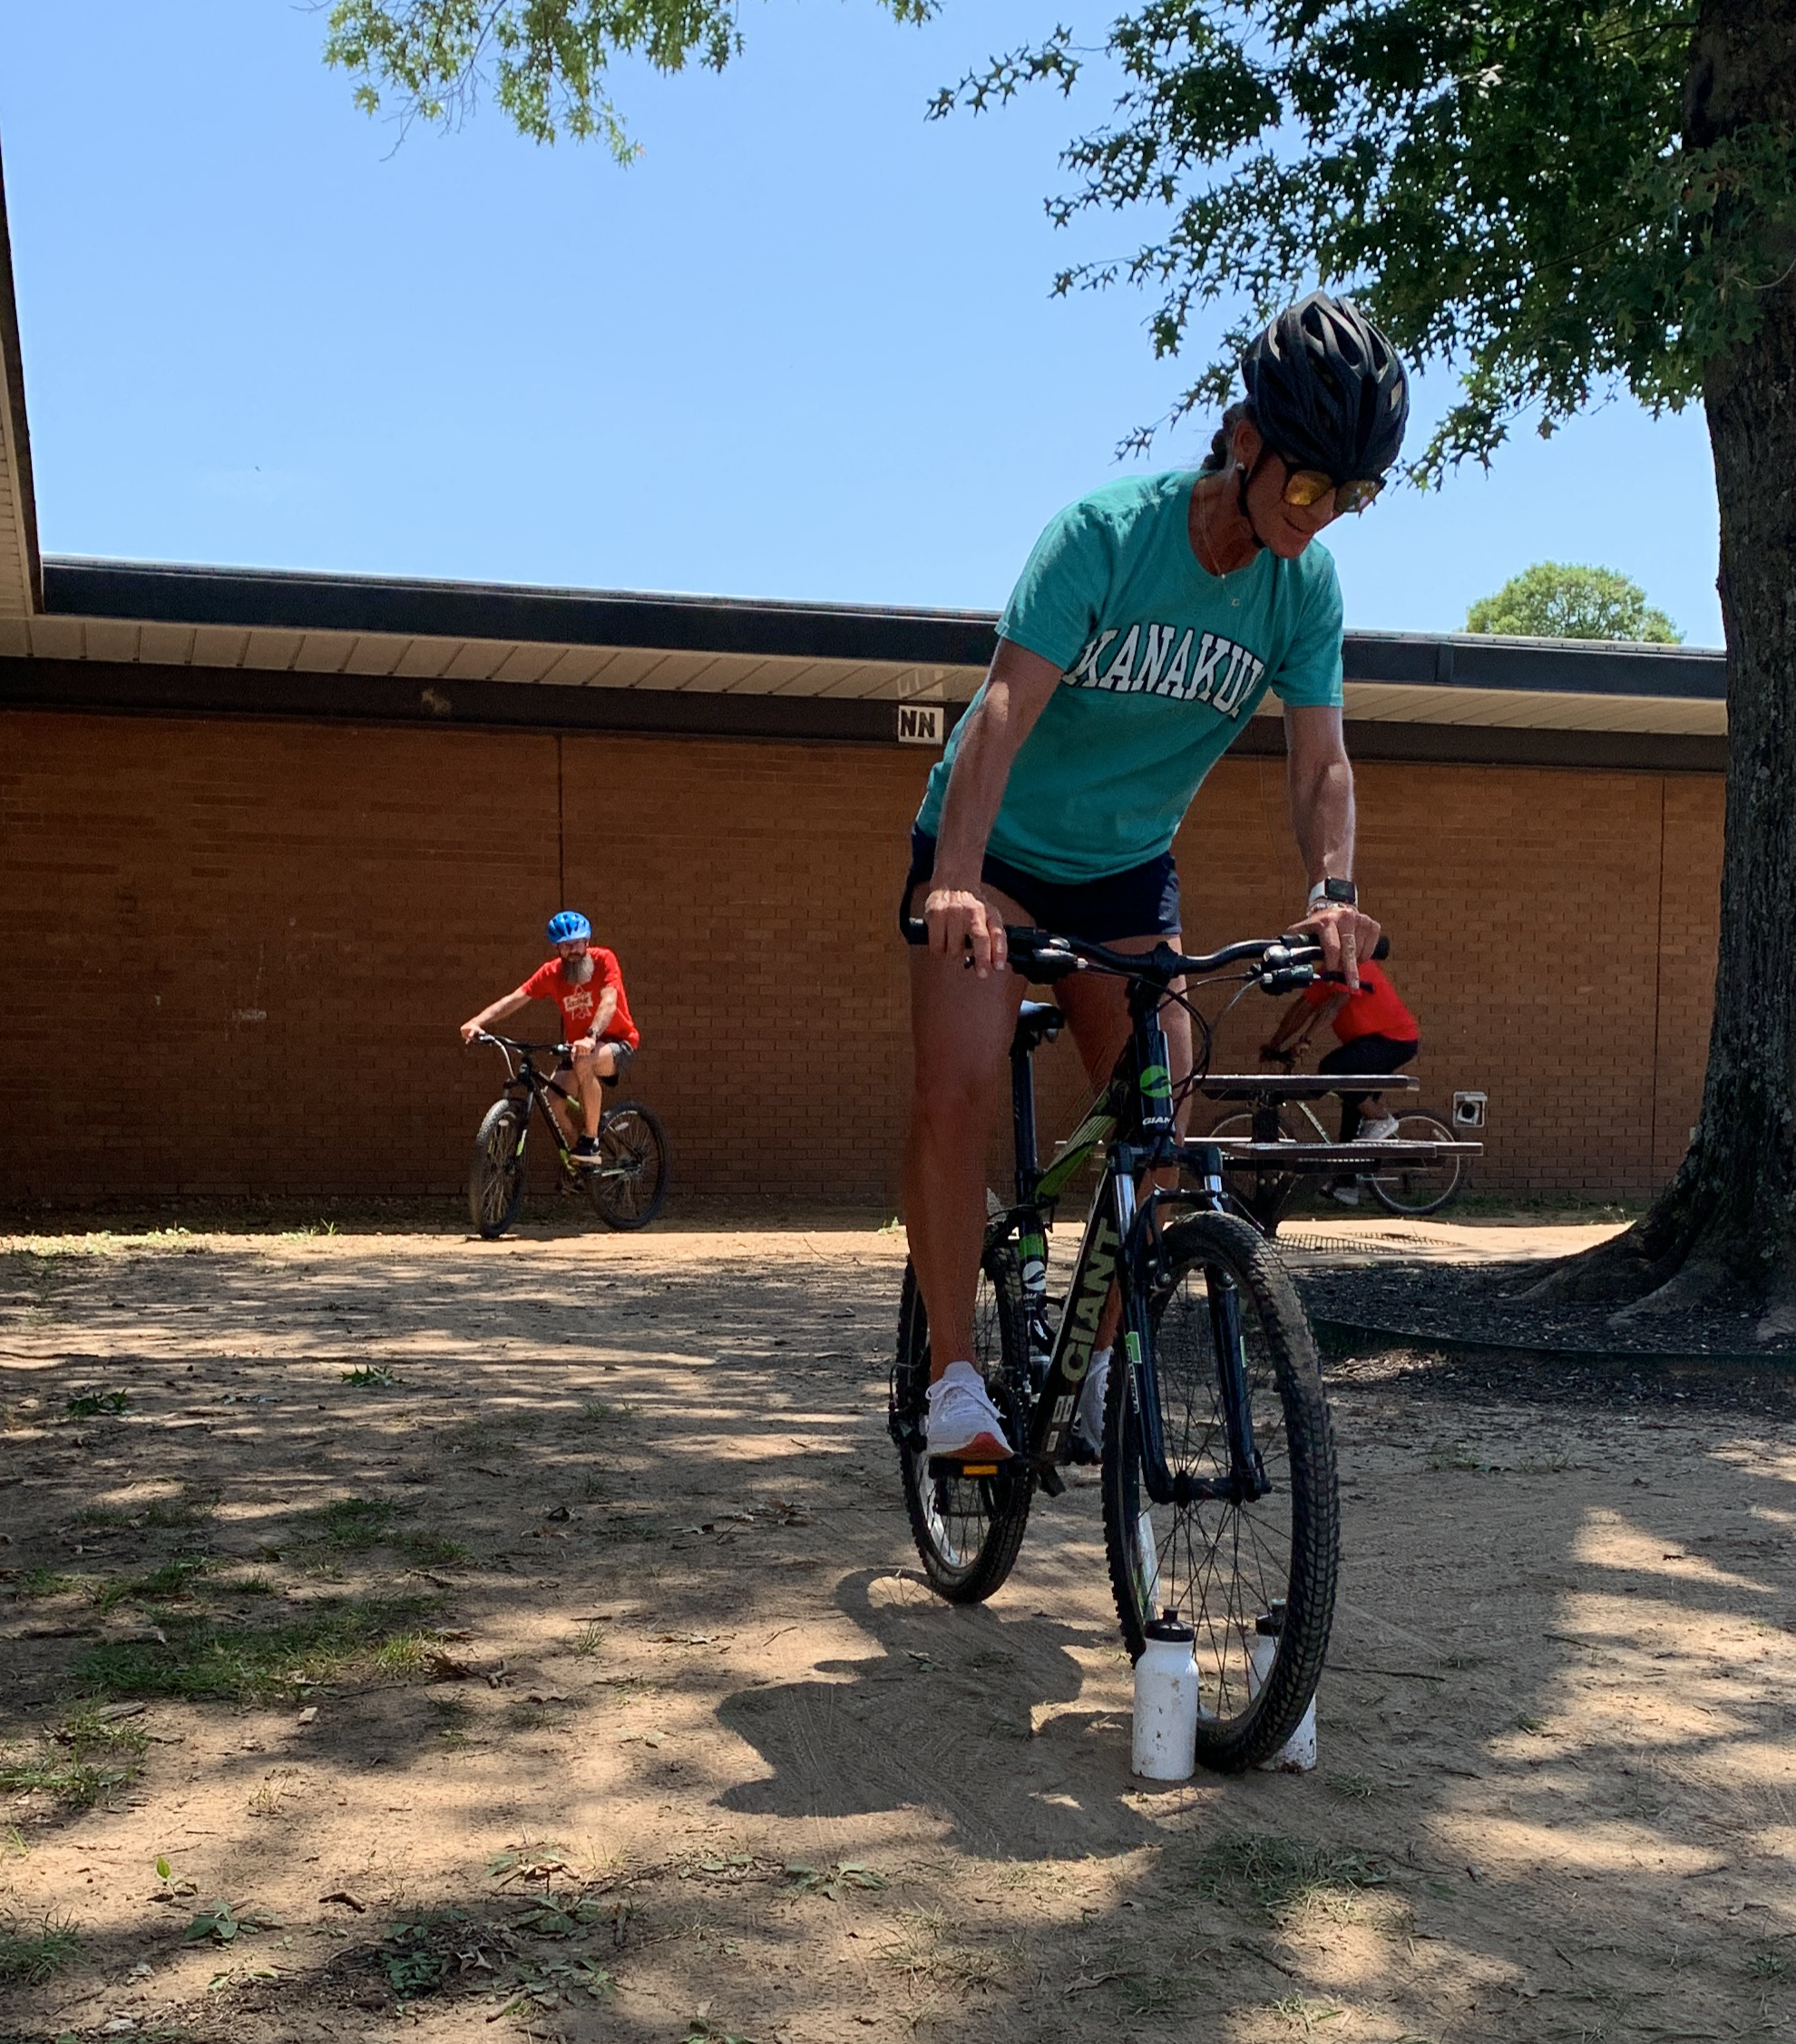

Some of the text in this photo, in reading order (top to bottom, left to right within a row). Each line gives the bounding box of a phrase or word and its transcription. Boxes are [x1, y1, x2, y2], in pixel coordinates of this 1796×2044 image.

[900, 709, 935, 738] NN
[1142, 1116, 1173, 1125] GIAN
[1061, 1216, 1120, 1381] GIANT
